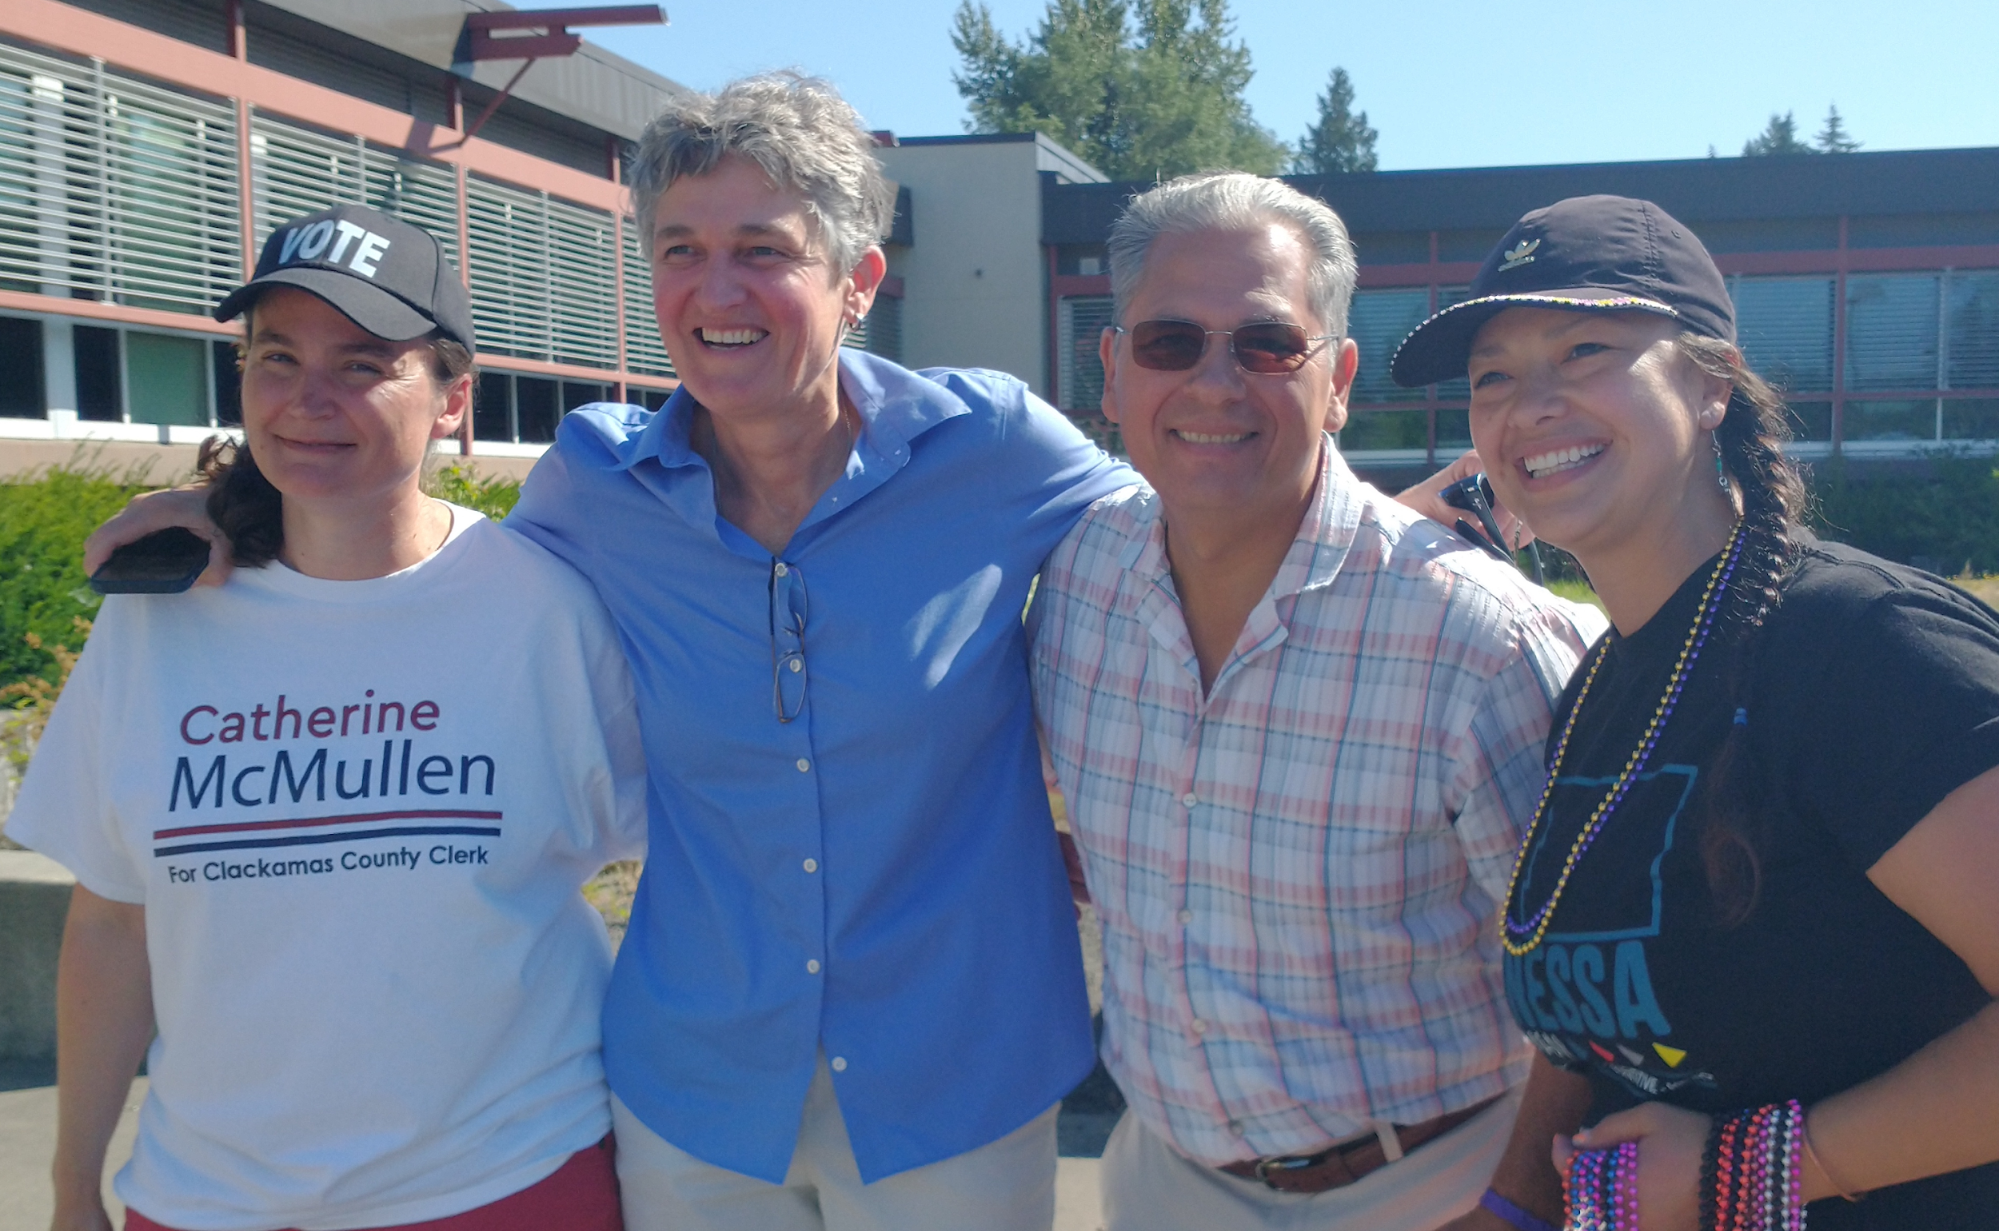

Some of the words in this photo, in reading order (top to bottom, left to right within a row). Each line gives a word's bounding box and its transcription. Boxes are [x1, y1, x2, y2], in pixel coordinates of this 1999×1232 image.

[278, 219, 391, 278] VOTE
[179, 689, 440, 745] Catherine
[168, 739, 496, 812] McMullen
[167, 865, 197, 883] For
[203, 856, 334, 882] Clackamas
[340, 846, 421, 870] County
[429, 845, 488, 866] Clerk
